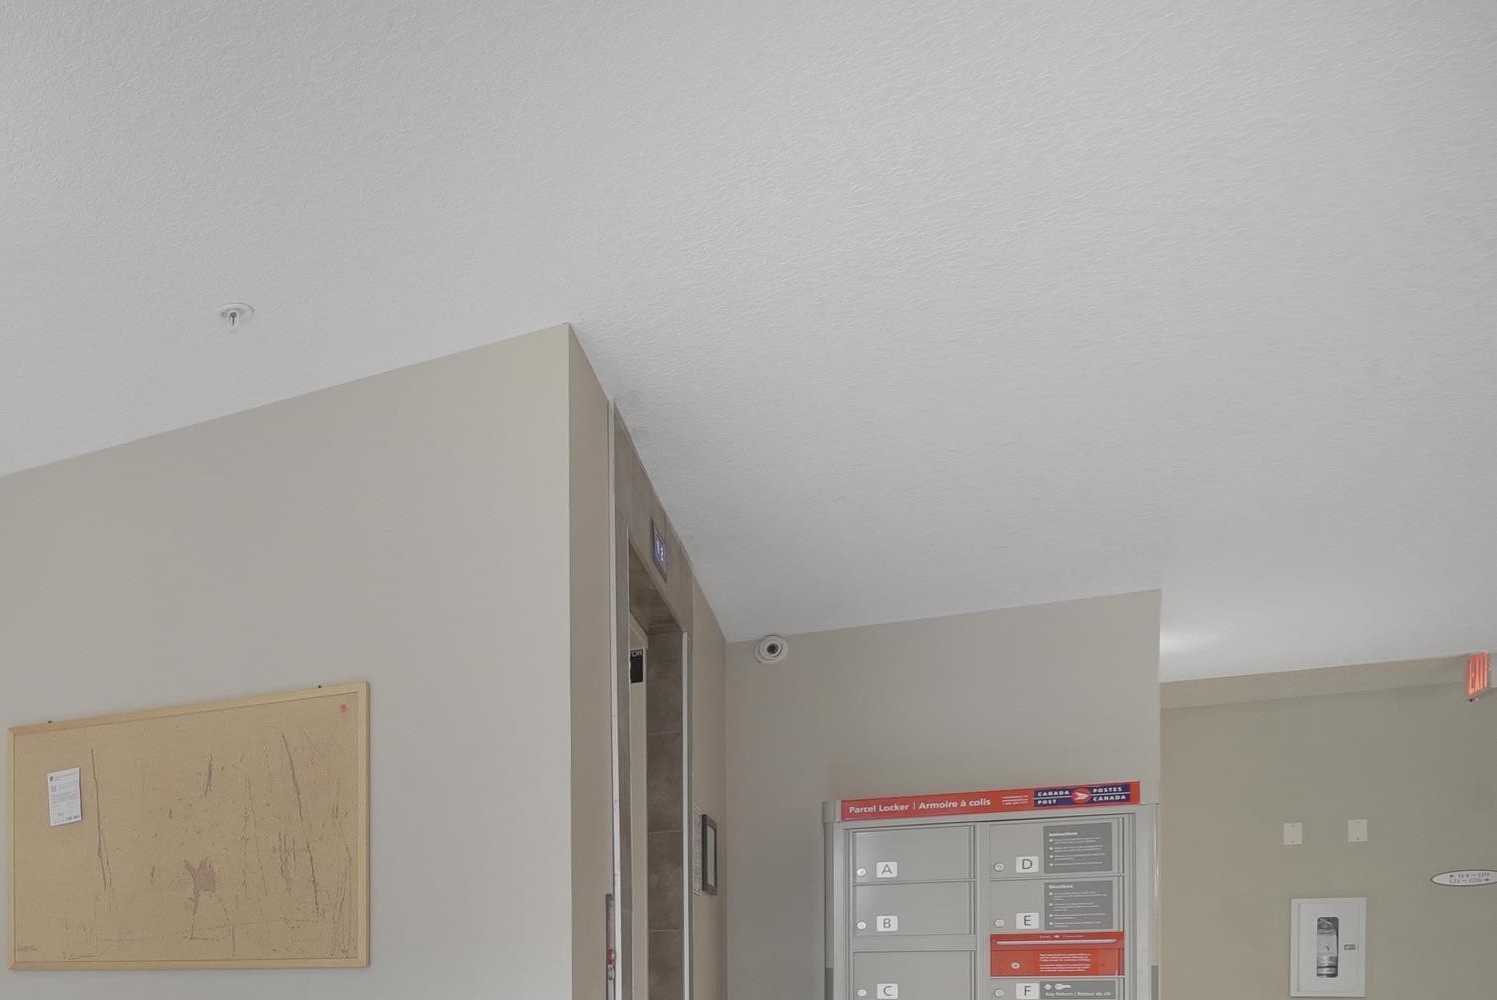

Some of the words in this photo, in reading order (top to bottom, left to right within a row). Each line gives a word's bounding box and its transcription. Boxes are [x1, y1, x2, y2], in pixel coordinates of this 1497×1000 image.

[1093, 794, 1127, 802] CANADA
[849, 804, 876, 814] Parcel
[879, 802, 909, 812] Locker
[919, 800, 958, 810] Armoire
[960, 799, 967, 808] à
[969, 798, 991, 807] colis
[881, 864, 893, 875] A
[1021, 858, 1033, 870] D
[883, 918, 892, 929] B
[1023, 915, 1032, 926] E
[883, 985, 893, 996] C
[1023, 985, 1032, 996] F
